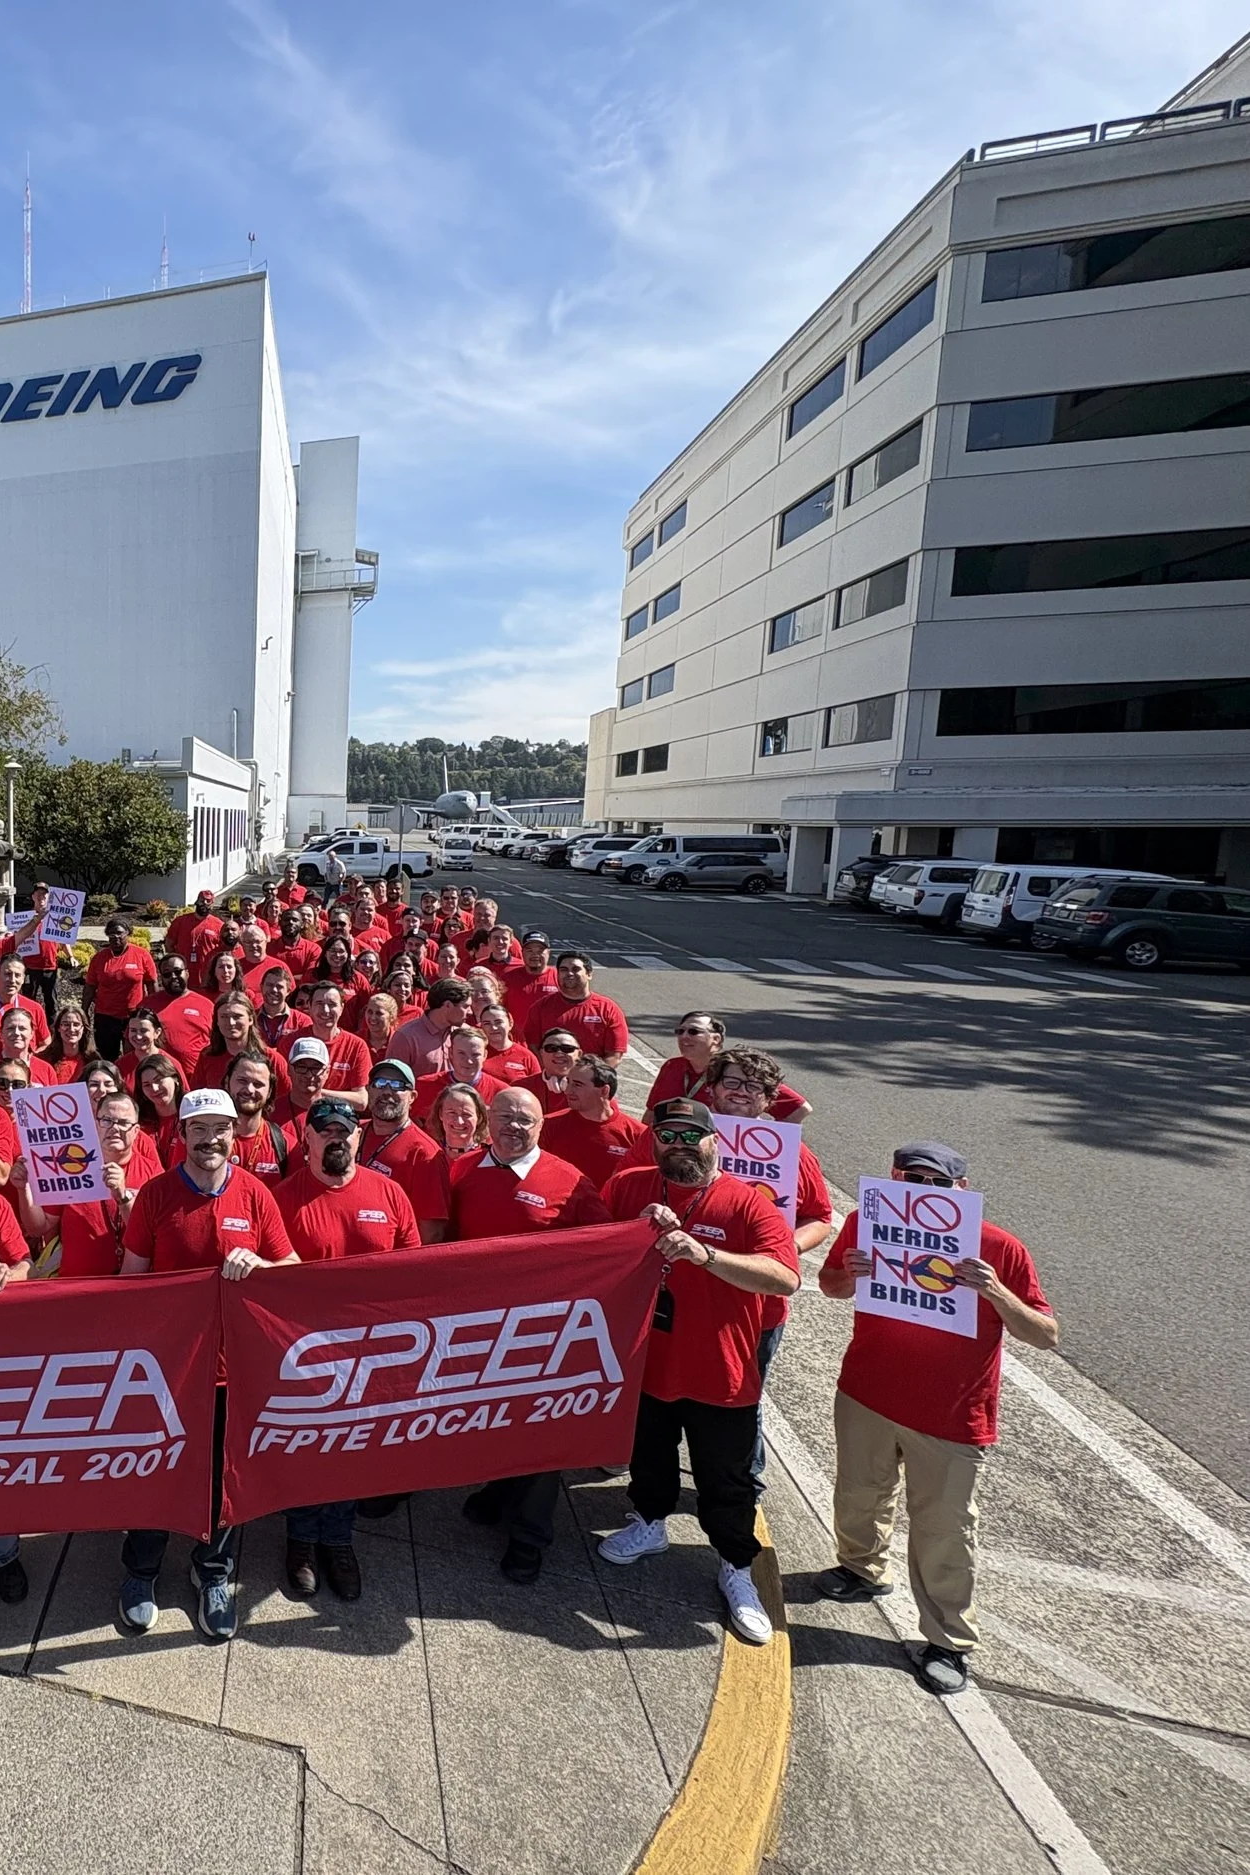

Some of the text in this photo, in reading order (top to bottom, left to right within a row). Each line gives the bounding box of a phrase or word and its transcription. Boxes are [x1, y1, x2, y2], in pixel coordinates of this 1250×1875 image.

[50, 905, 76, 916] NERDS
[53, 891, 78, 908] NO
[45, 928, 72, 939] BIRDS
[25, 1092, 78, 1125] NO
[26, 1124, 83, 1143] NERDS
[716, 1124, 783, 1161] NO
[718, 1156, 781, 1179] ERDS
[38, 1174, 94, 1193] BIRDS
[864, 1188, 876, 1220] SPEEA
[880, 1190, 962, 1233] NO
[692, 1224, 726, 1240] SPEEA
[873, 1224, 959, 1254] NERDS
[870, 1282, 956, 1316] BIRDS
[265, 1298, 625, 1409] SPEEA
[247, 1386, 624, 1459] IFPTE LOCAL 2001
[79, 1439, 187, 1483] 2001
